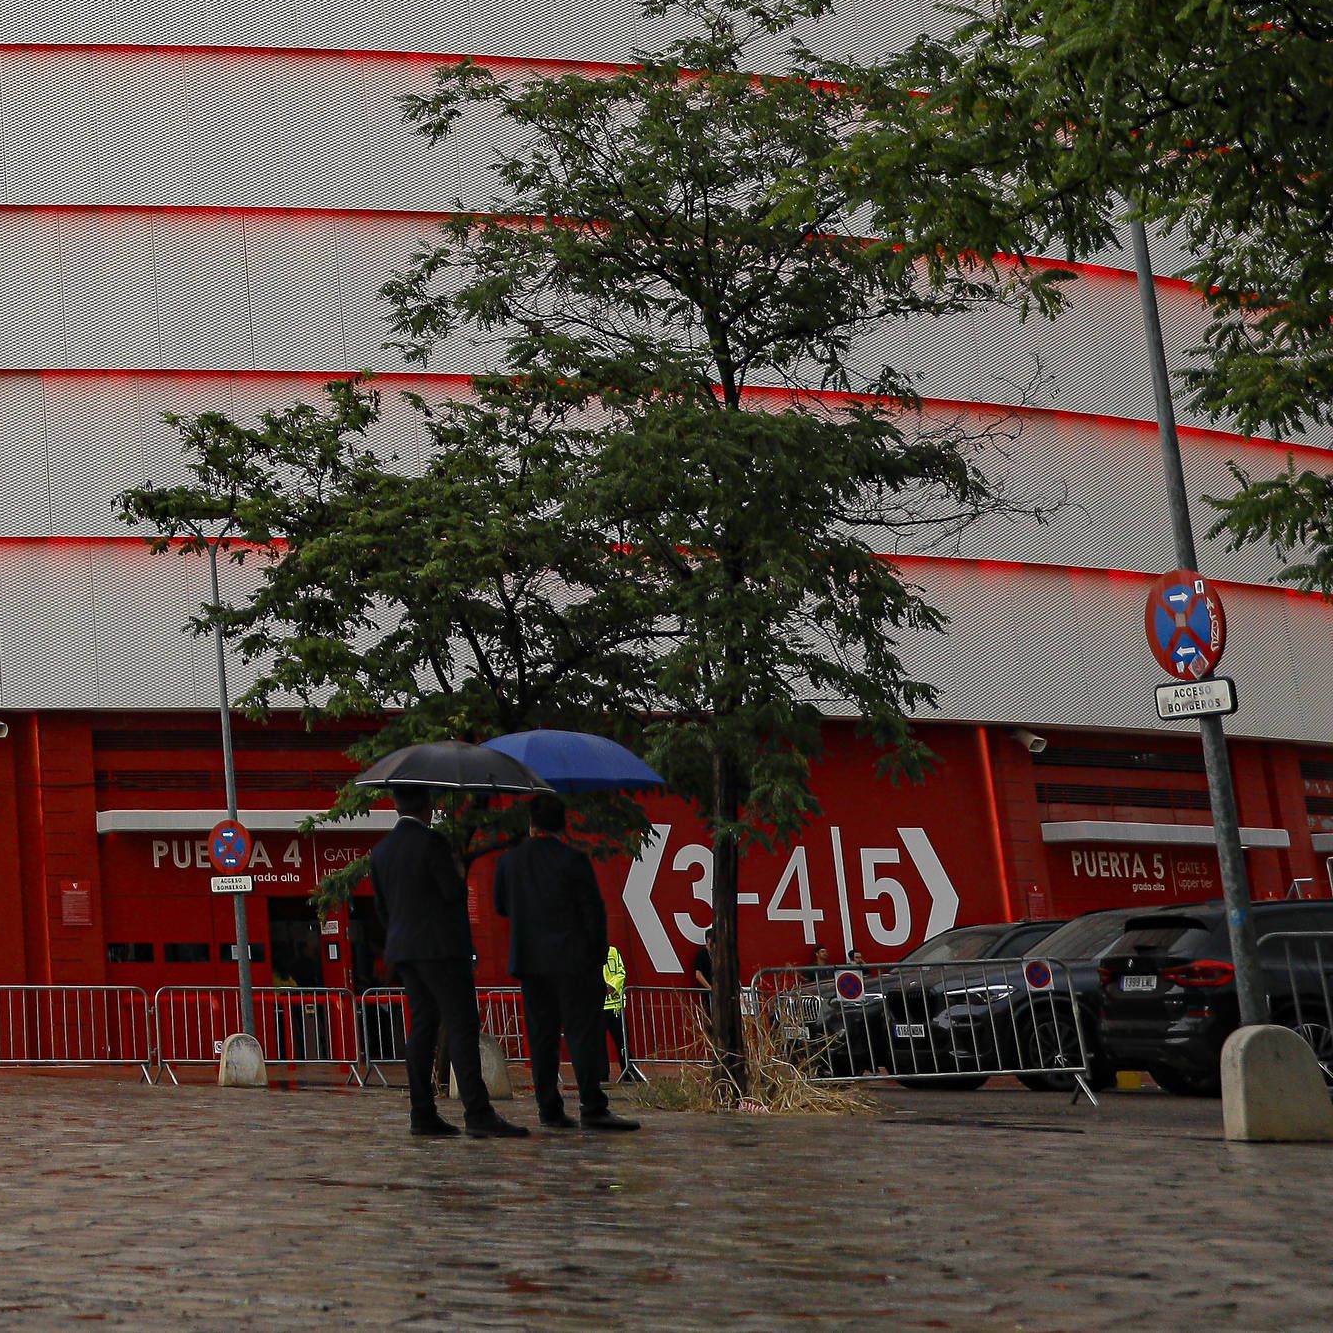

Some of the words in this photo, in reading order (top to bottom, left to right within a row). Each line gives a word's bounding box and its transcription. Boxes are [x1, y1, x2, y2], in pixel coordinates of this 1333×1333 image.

[1174, 686, 1212, 699] ACCESO
[1167, 698, 1221, 713] BOMBEROS
[153, 840, 273, 868] PUEA
[283, 840, 302, 868] 4
[1071, 851, 1148, 879] PUERTA
[1153, 853, 1165, 880] 5
[254, 873, 278, 882] rada
[280, 873, 300, 882] alta
